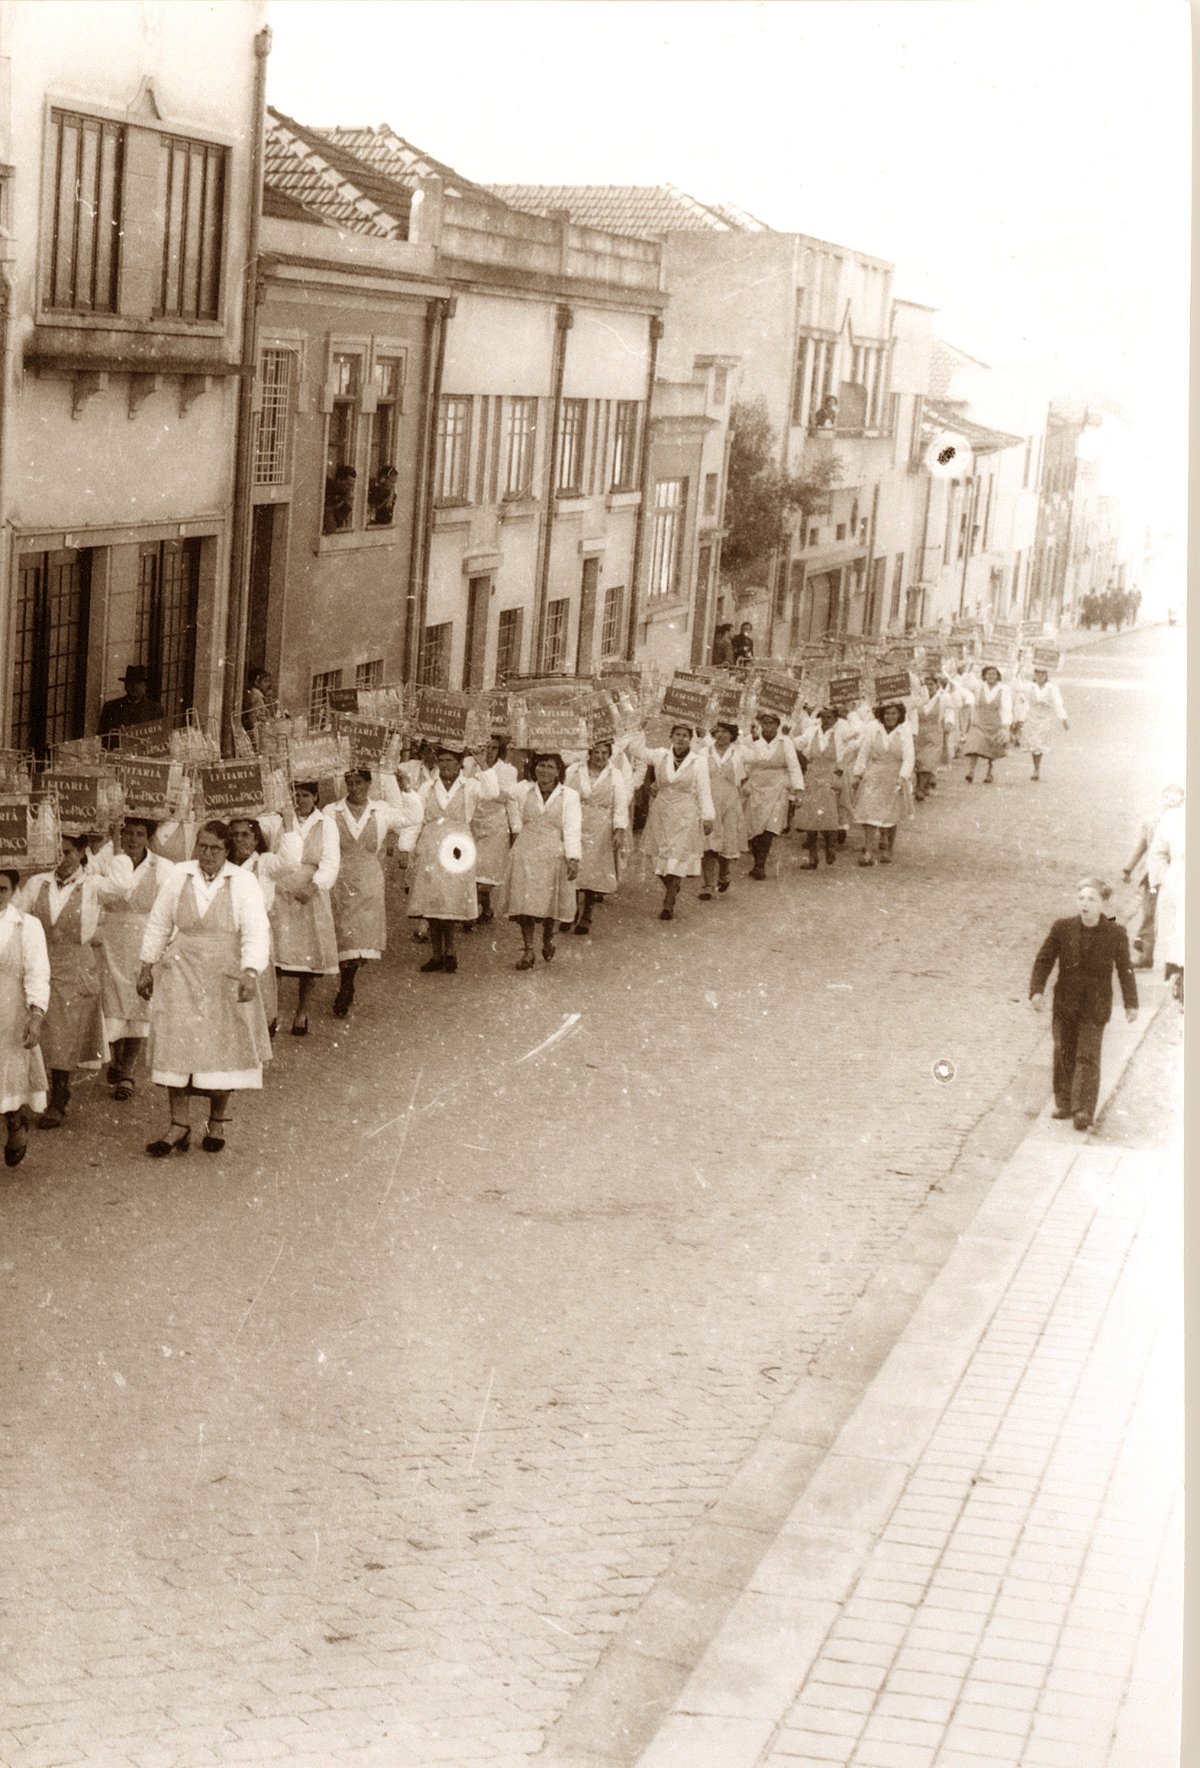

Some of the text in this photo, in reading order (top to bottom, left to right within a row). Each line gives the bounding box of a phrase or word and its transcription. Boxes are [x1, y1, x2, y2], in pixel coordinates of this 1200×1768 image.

[209, 770, 255, 782] LEITARIA
[71, 805, 97, 818] PAÇO
[0, 837, 28, 850] PAÇO
